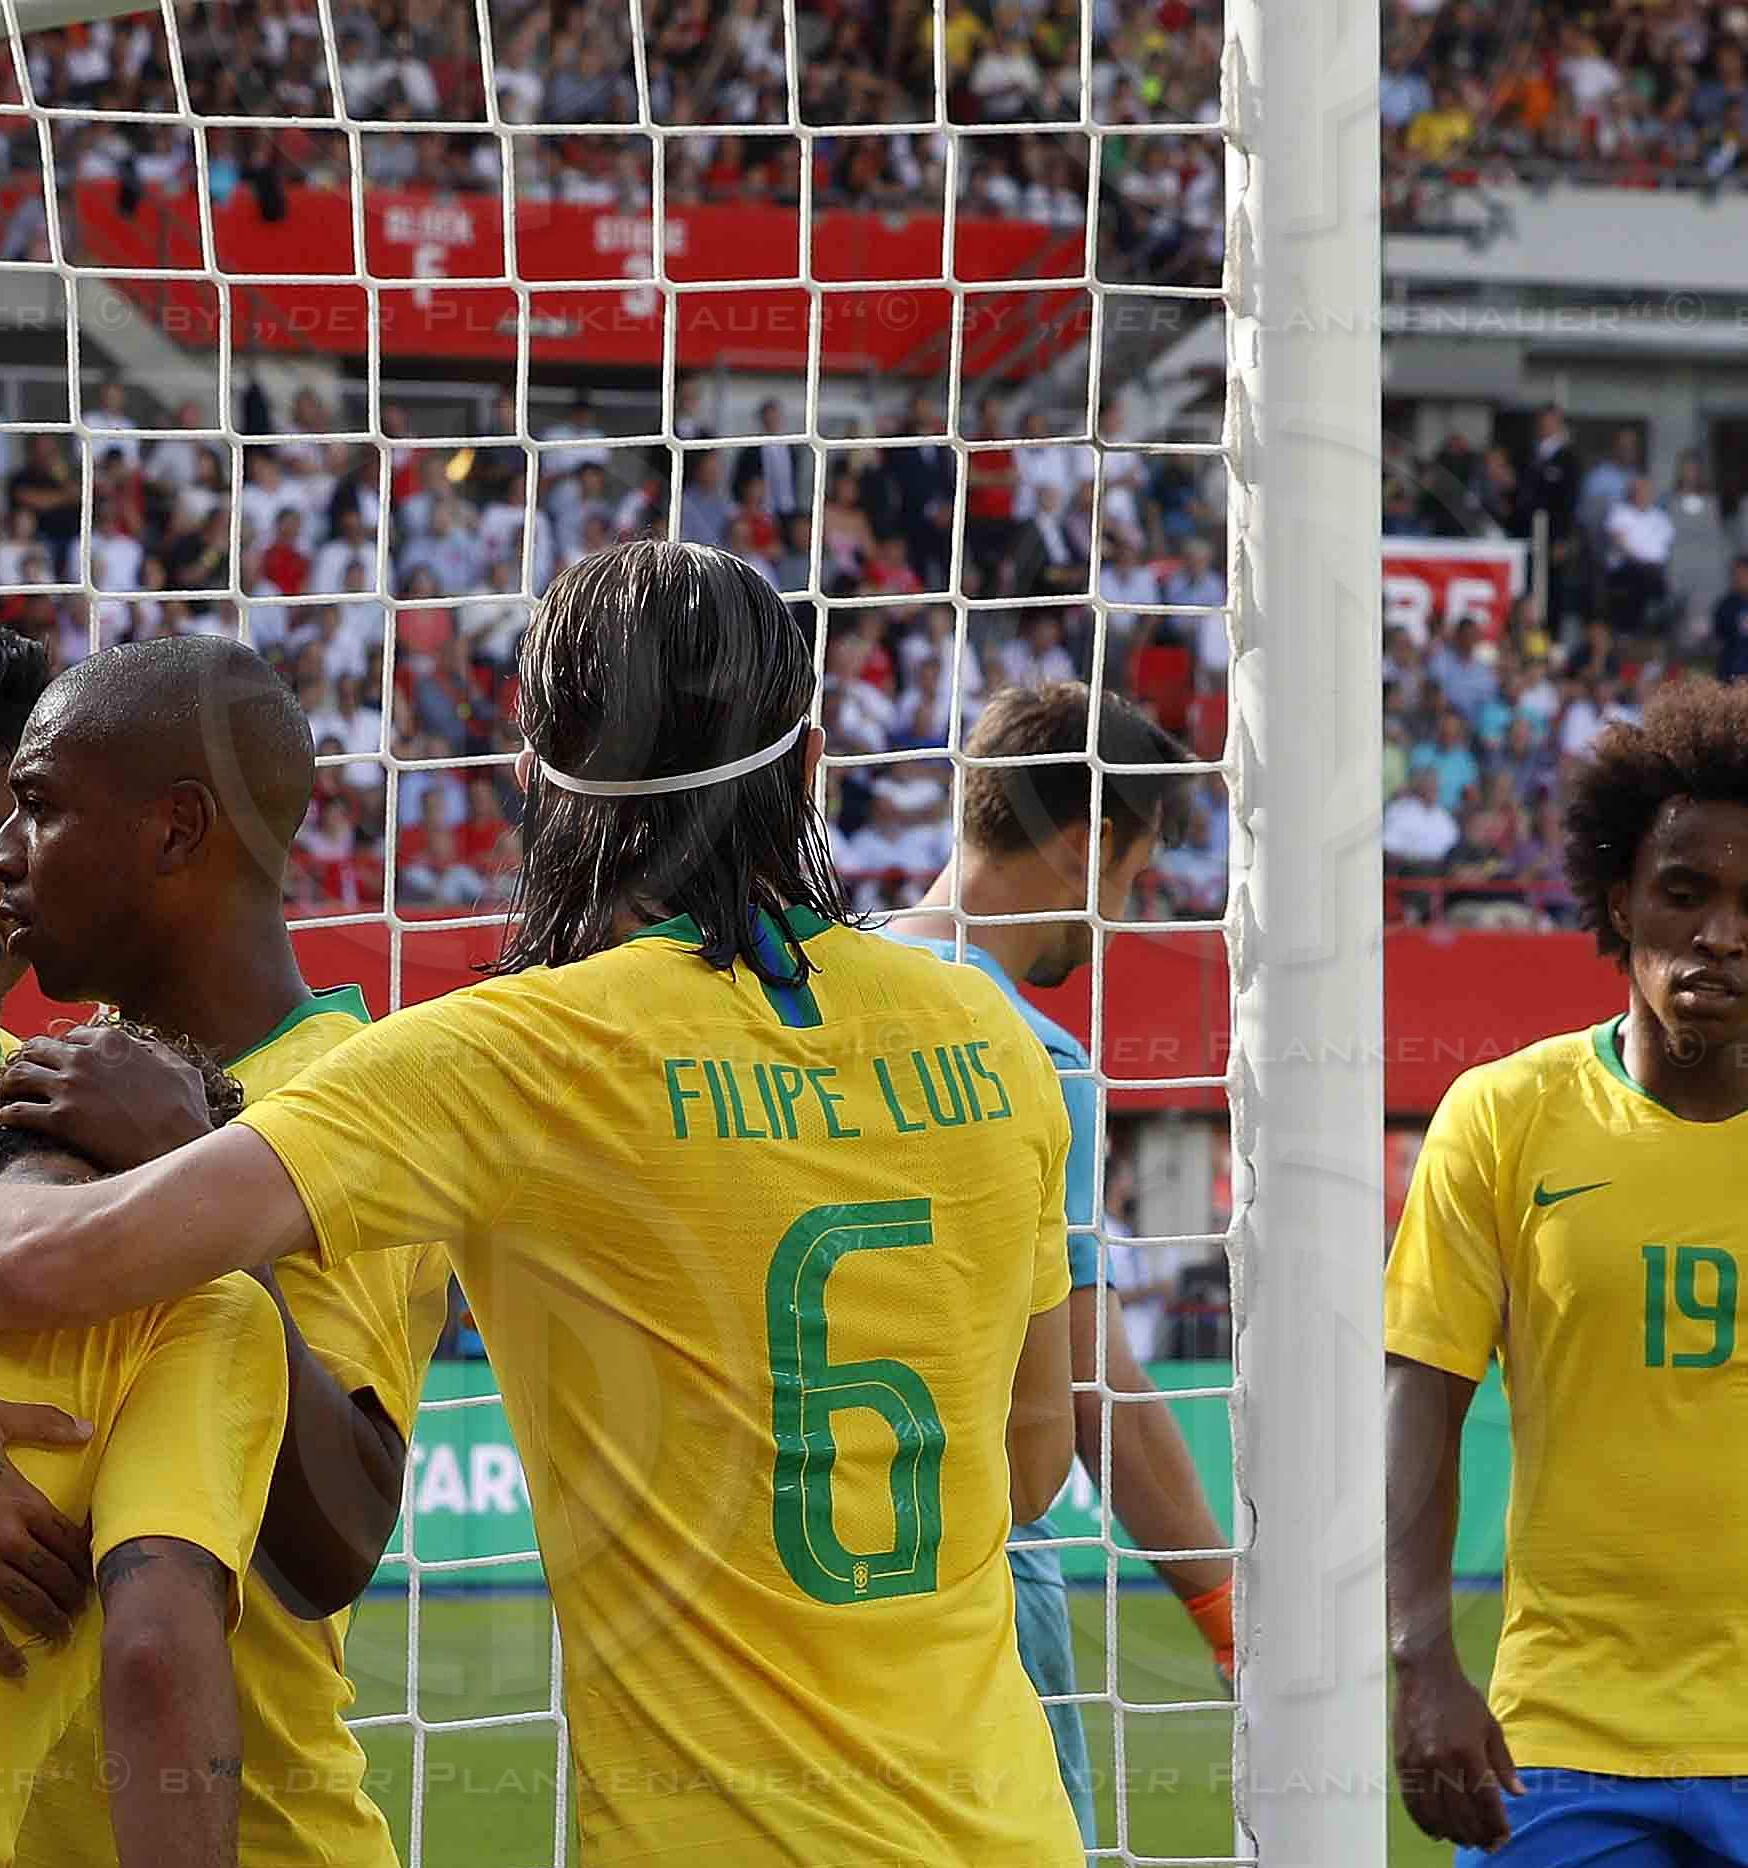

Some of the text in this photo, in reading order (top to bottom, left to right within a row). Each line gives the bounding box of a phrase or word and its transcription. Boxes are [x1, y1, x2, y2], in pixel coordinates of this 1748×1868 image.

[664, 1039, 1015, 1141] FILIPE LUIS
[1642, 1244, 1739, 1369] 19
[764, 1197, 948, 1606] 6
